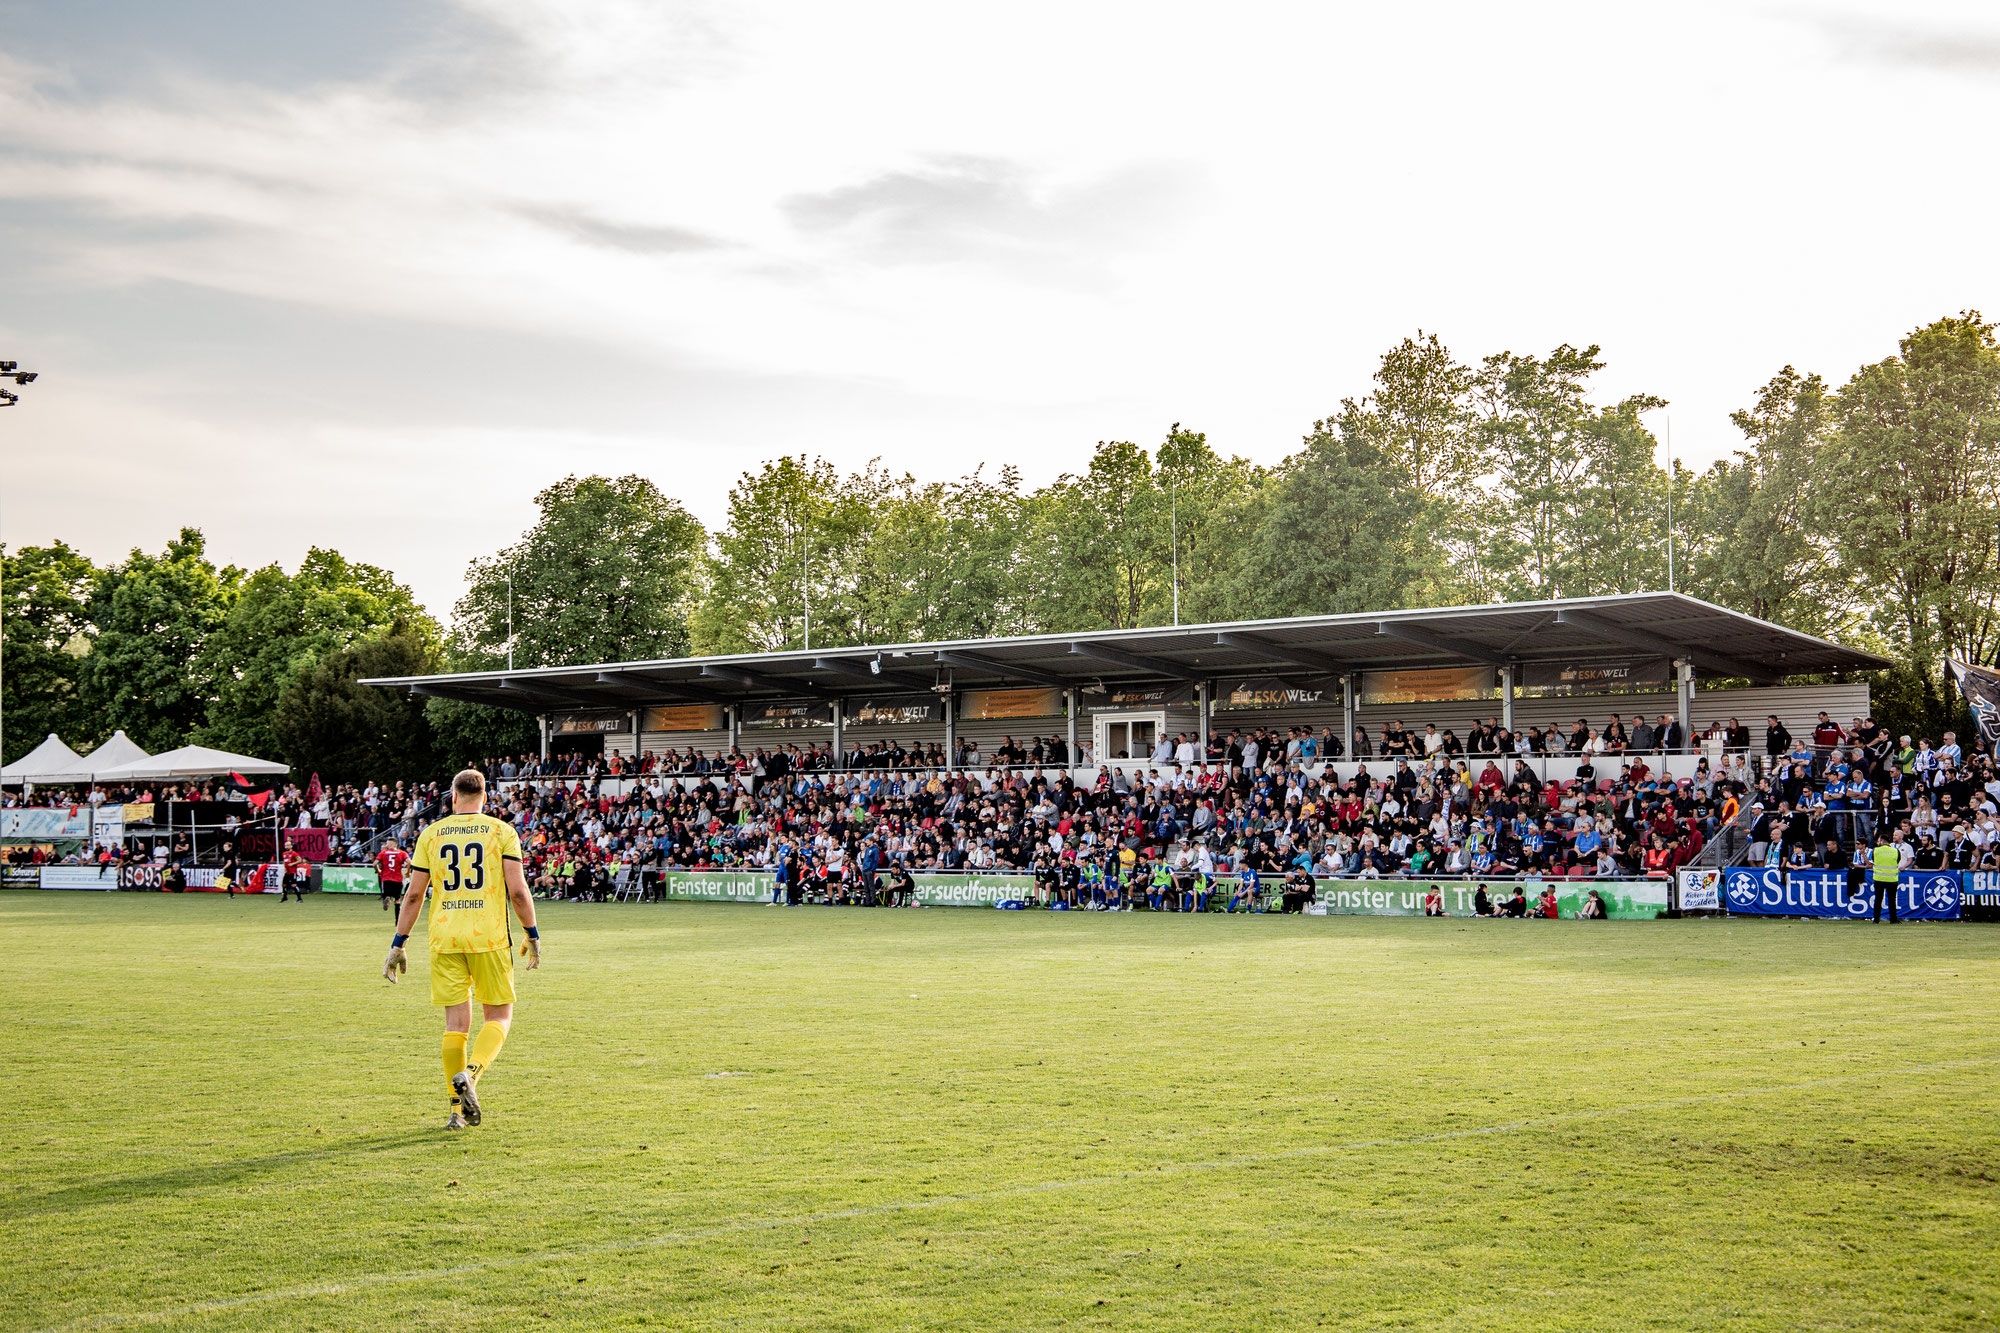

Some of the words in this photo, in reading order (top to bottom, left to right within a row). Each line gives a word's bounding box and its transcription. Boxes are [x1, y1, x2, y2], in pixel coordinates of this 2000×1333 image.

[1579, 668, 1629, 680] ESKAWELT
[1125, 692, 1164, 702] ESKAWELT
[1255, 689, 1322, 703] ESKAWELT
[776, 708, 808, 717] ESKAWELT
[877, 706, 930, 720] ESKAWELT
[577, 720, 620, 732] ESKAWELT
[480, 825, 490, 833] SV
[388, 854, 396, 868] 5
[439, 842, 485, 892] 33
[669, 876, 722, 896] Fenster
[727, 876, 755, 896] und
[1973, 871, 2000, 891] BL
[1315, 885, 1394, 909] Fenster
[442, 899, 484, 910] SCHLEICHER
